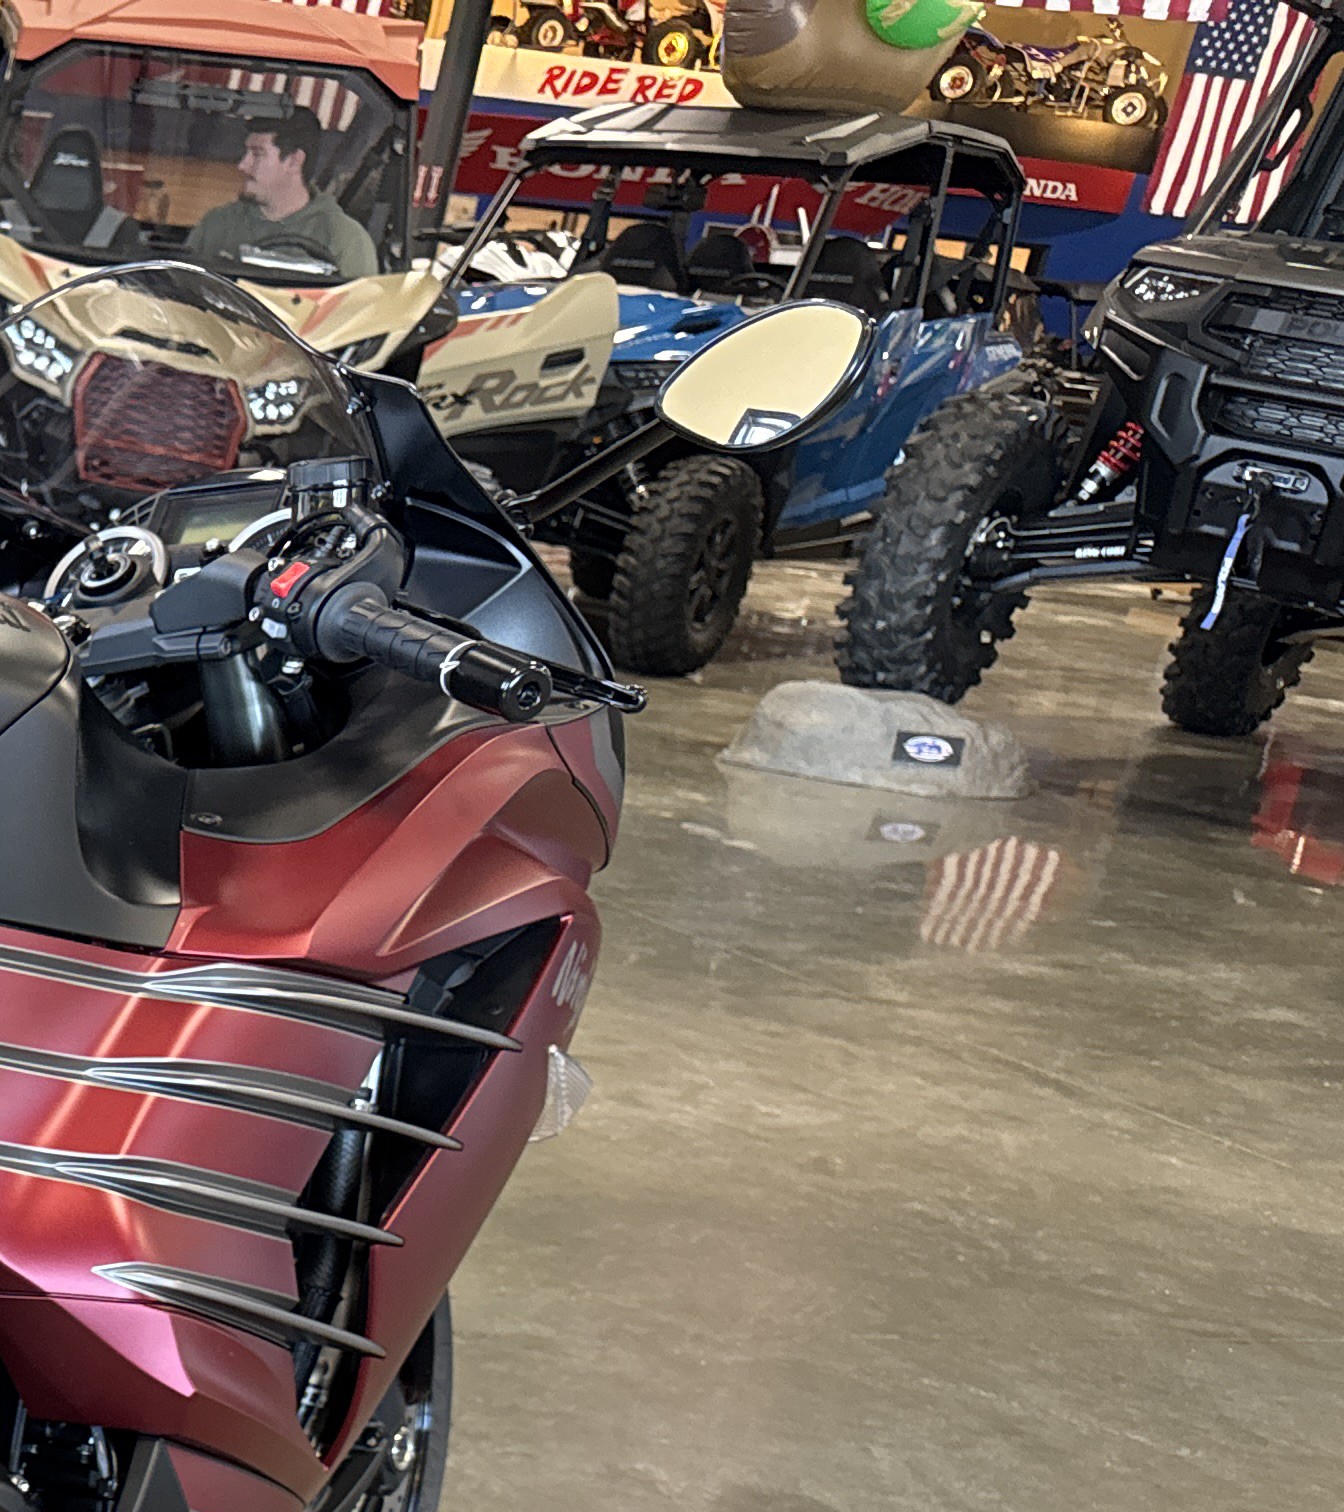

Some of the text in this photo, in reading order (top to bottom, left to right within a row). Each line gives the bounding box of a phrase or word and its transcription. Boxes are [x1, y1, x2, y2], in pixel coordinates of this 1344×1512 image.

[538, 64, 704, 104] RIDE RED
[1023, 177, 1080, 202] NDA
